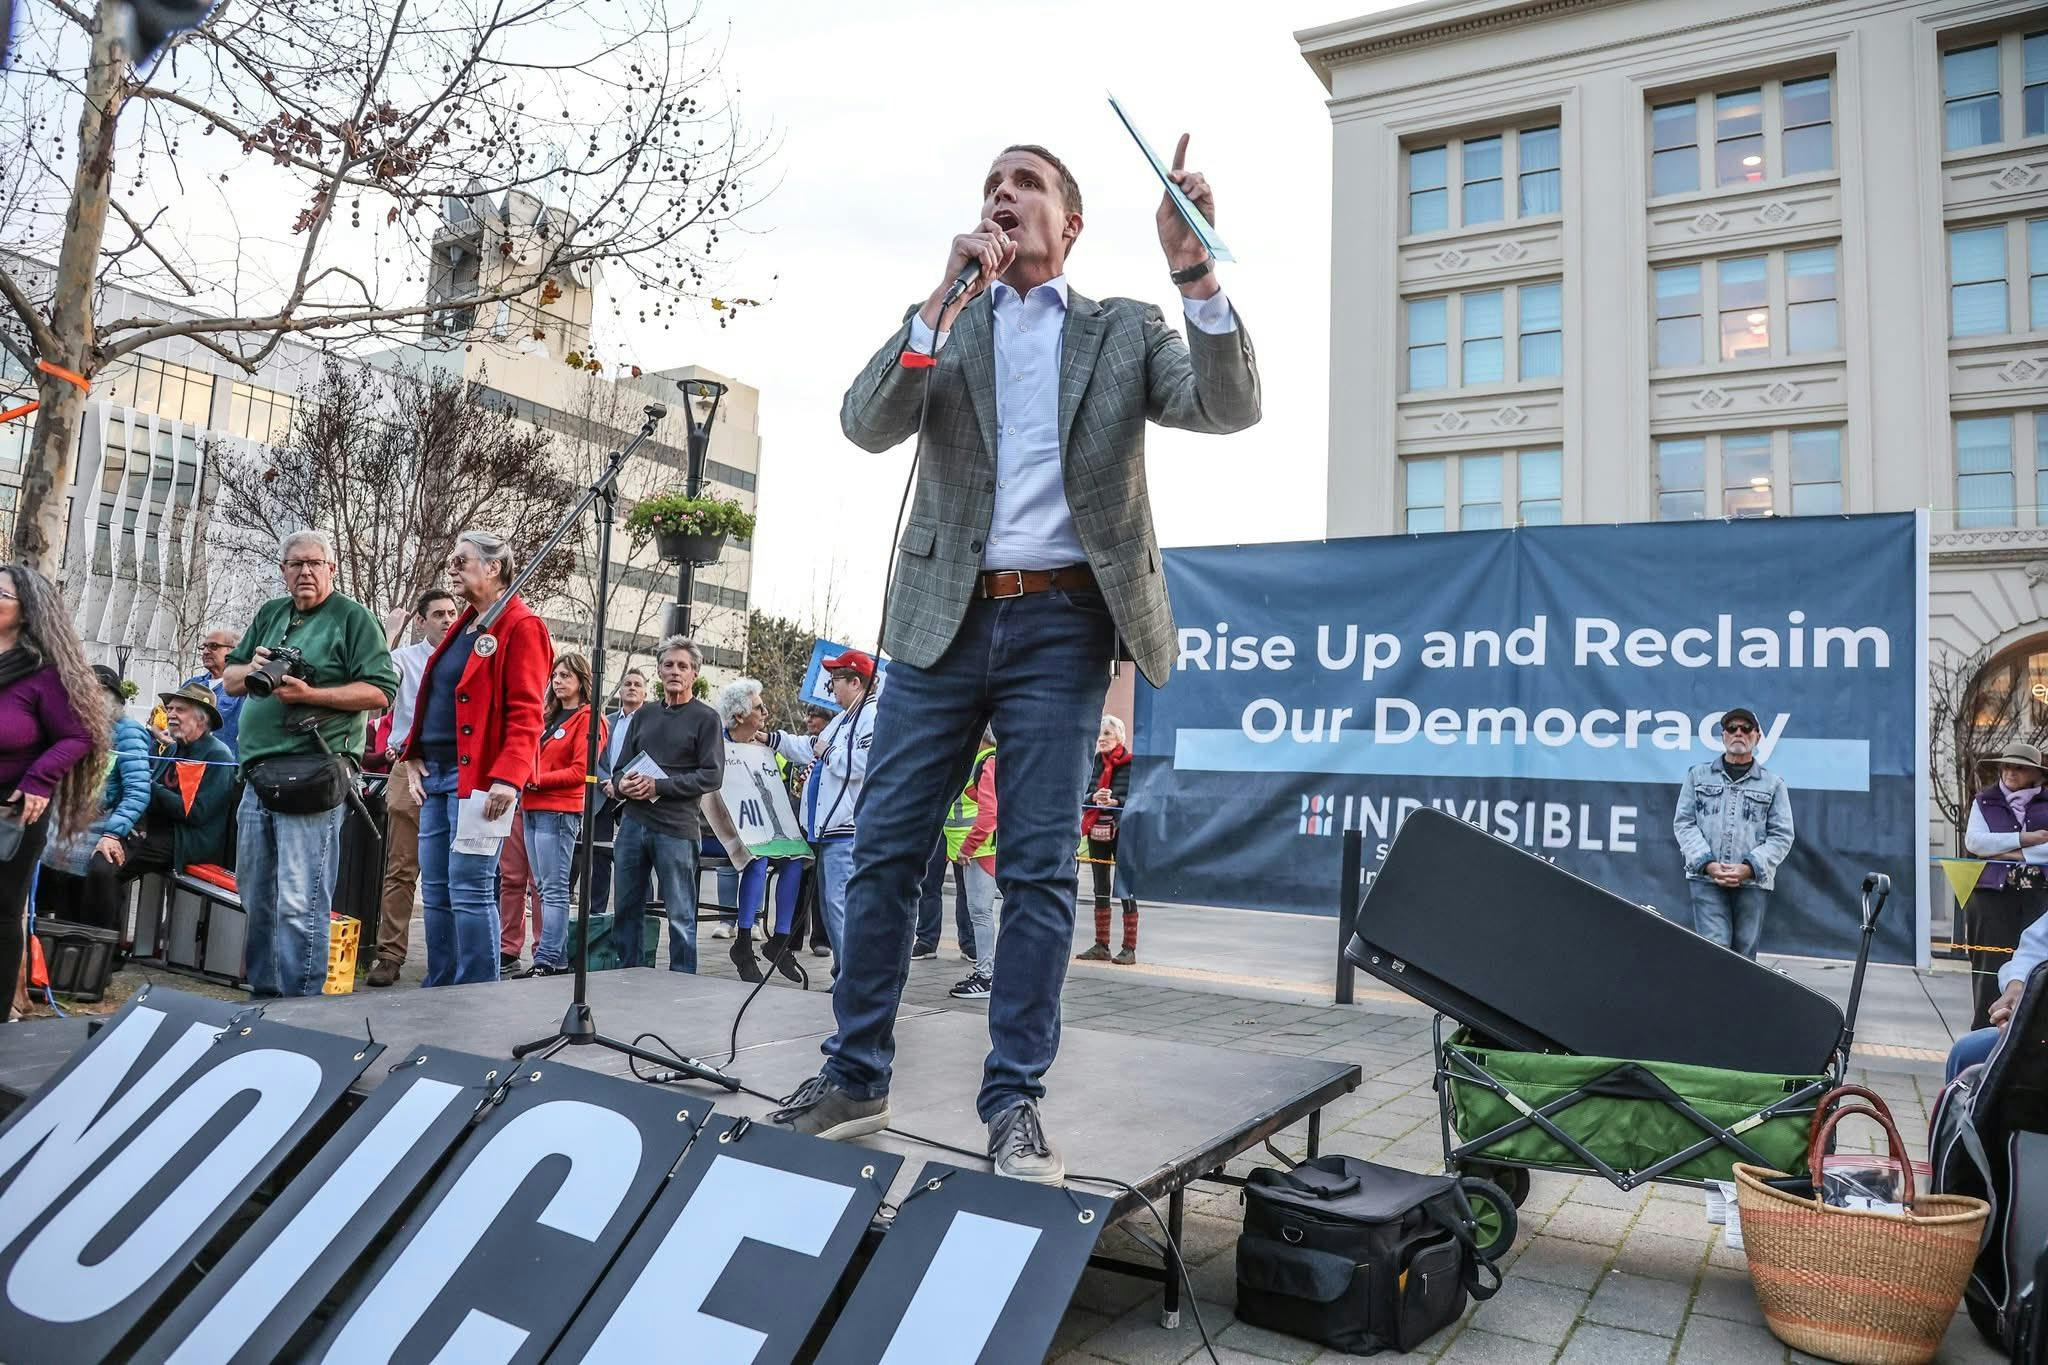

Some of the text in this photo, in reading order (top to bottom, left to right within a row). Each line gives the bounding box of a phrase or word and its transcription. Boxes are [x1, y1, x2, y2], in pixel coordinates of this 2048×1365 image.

[1177, 610, 1891, 681] Rise Up and Reclaim
[1241, 698, 1353, 744] Our
[738, 799, 765, 830] All
[1343, 795, 1638, 852] INISIBLE
[0, 1006, 323, 1323] NO
